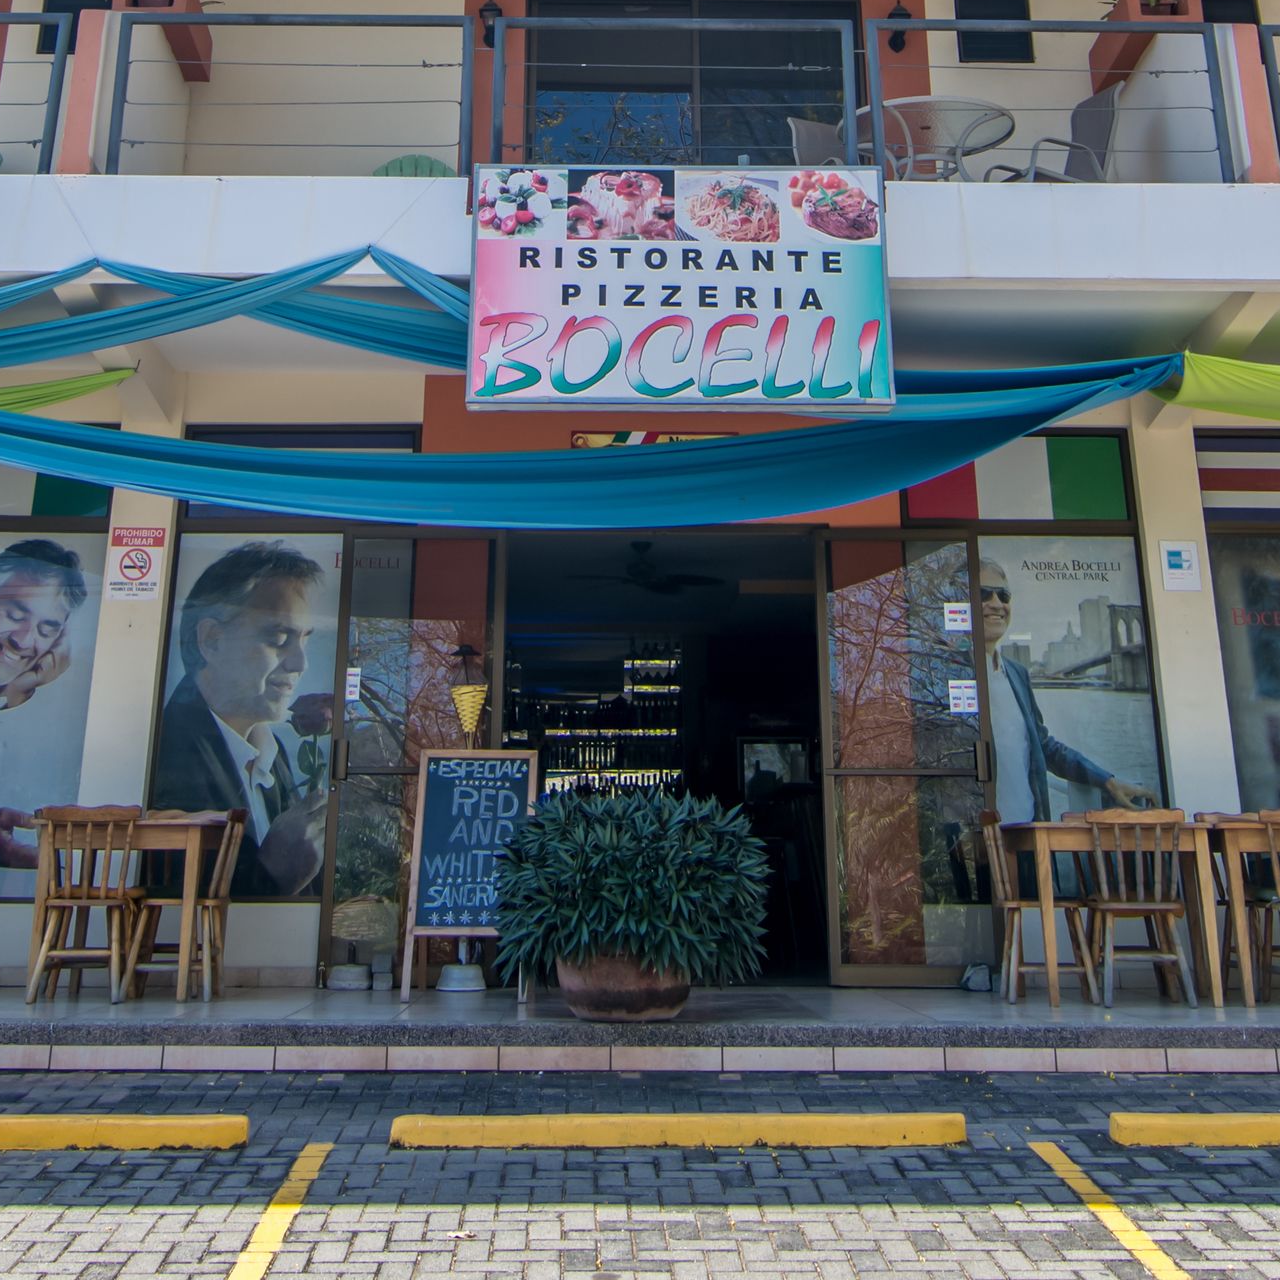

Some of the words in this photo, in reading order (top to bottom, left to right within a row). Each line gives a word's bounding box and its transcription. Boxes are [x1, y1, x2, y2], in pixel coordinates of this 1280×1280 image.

[520, 246, 842, 273] RISTORANTE
[561, 284, 823, 310] PIZZERIA
[473, 313, 880, 398] BOCELLI
[114, 529, 163, 537] PROHIBIDO
[122, 537, 154, 545] FUMAR
[1021, 560, 1069, 571] ANDREA
[1072, 560, 1120, 571] BOCELLI
[1035, 572, 1080, 581] CENTRAL
[1083, 572, 1109, 582] PARK
[438, 759, 523, 778] ESPECIAL
[451, 786, 519, 819] RED
[448, 818, 514, 846] AND
[423, 884, 499, 908] SANGRI
